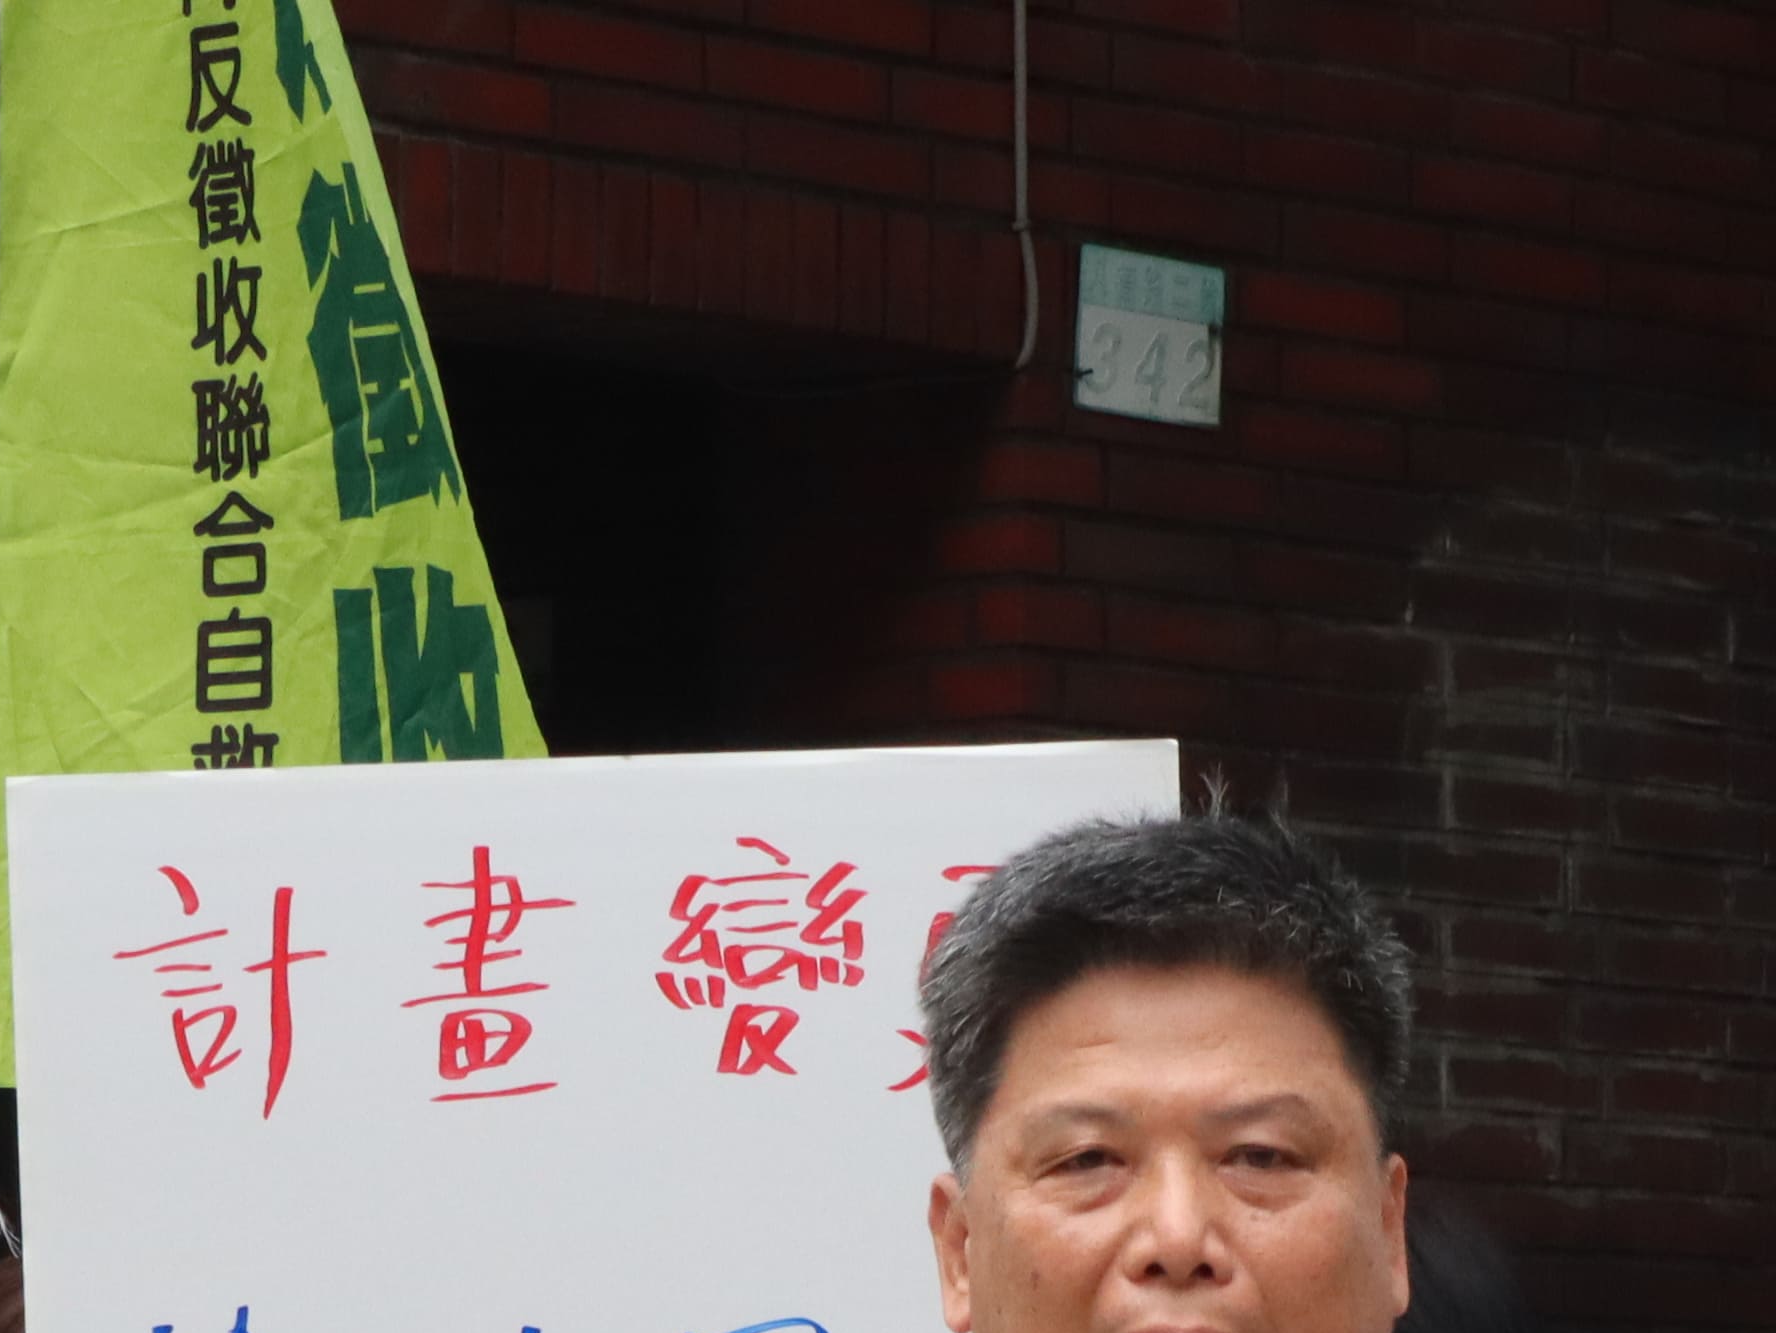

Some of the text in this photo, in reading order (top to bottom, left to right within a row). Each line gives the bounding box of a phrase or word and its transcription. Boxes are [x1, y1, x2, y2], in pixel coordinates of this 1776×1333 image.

[183, 0, 280, 769] 反徵收聯合自
[274, 0, 506, 763] 徵收
